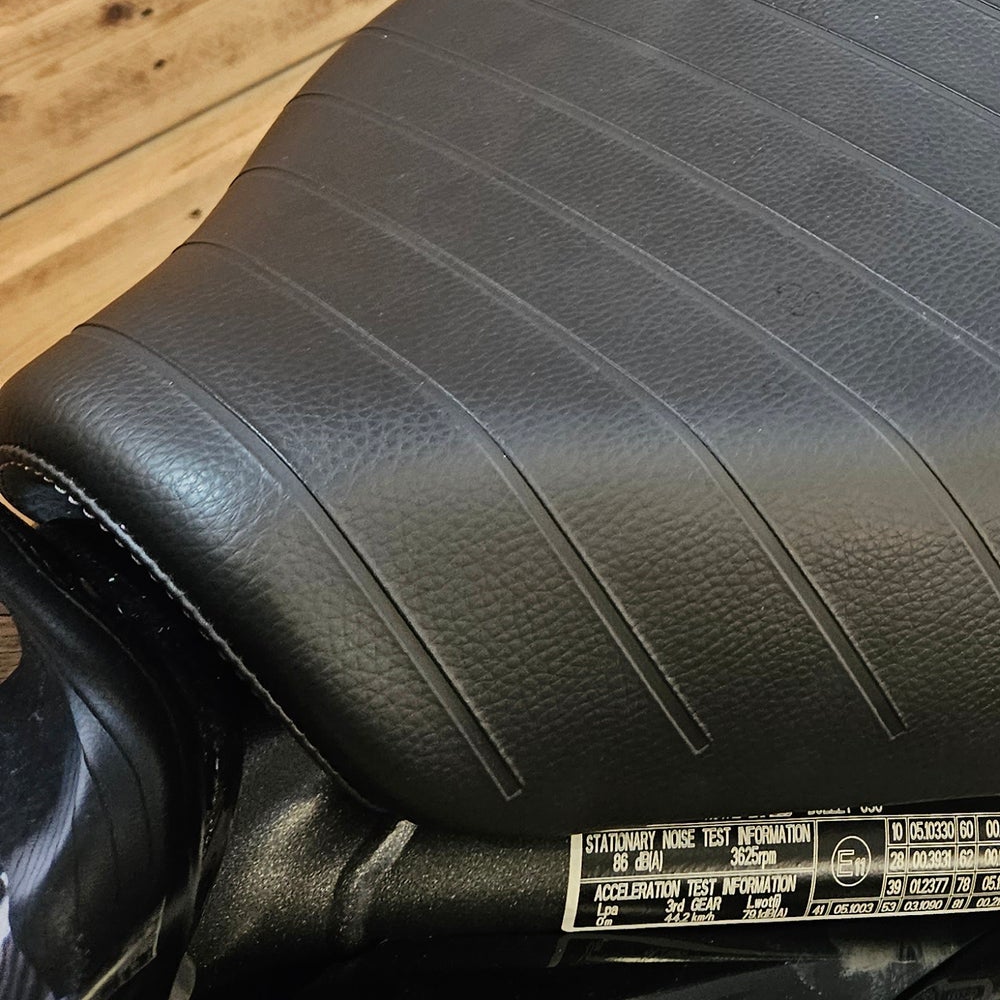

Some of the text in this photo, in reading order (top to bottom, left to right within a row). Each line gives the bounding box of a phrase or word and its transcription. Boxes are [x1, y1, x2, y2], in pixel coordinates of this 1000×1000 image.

[586, 823, 811, 854] STATIONARY NOISE TEST INFORMATION
[892, 821, 903, 841] 10
[909, 820, 954, 842] 05.10330
[959, 819, 974, 840] 60
[613, 846, 777, 872] 86 dB(A) 3625rpm
[890, 850, 905, 870] 28
[913, 849, 952, 869] 00.3931
[959, 848, 974, 868] 62
[594, 874, 797, 902] ACCELERATION TEST INFORMATION
[886, 875, 901, 896] 39
[909, 876, 949, 895] 01.2377
[956, 876, 971, 893] 78
[597, 902, 619, 918] Lpa
[665, 898, 686, 913] 3rd
[691, 896, 722, 912] GEAR
[812, 905, 825, 915] 41
[833, 902, 874, 915] 05.1003
[881, 900, 897, 913] 53
[903, 899, 943, 911] 03.1090
[951, 898, 964, 909] 81
